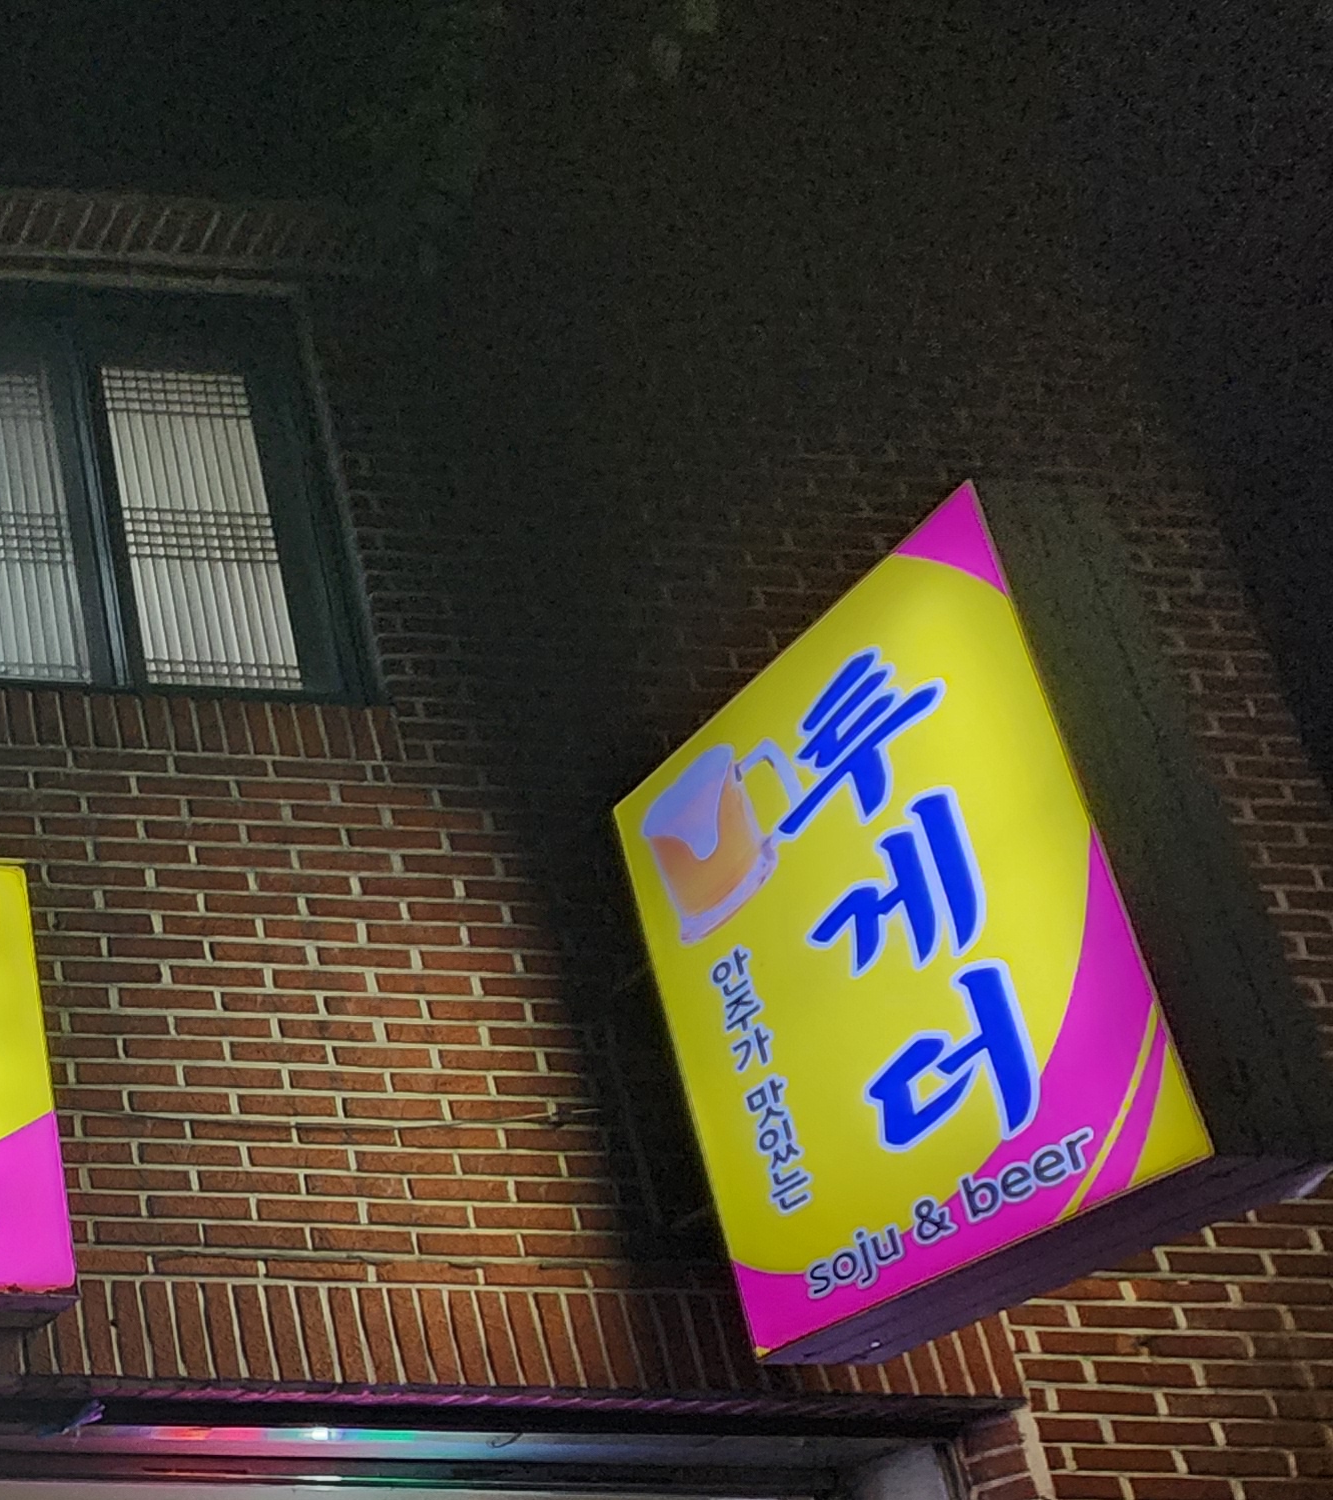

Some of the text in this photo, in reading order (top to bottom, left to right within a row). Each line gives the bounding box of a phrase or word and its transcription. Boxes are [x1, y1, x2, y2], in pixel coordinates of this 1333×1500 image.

[778, 647, 1039, 1149] 투게더
[711, 946, 811, 1212] 안주가 맛있는
[807, 1128, 1093, 1296] soju & beer
